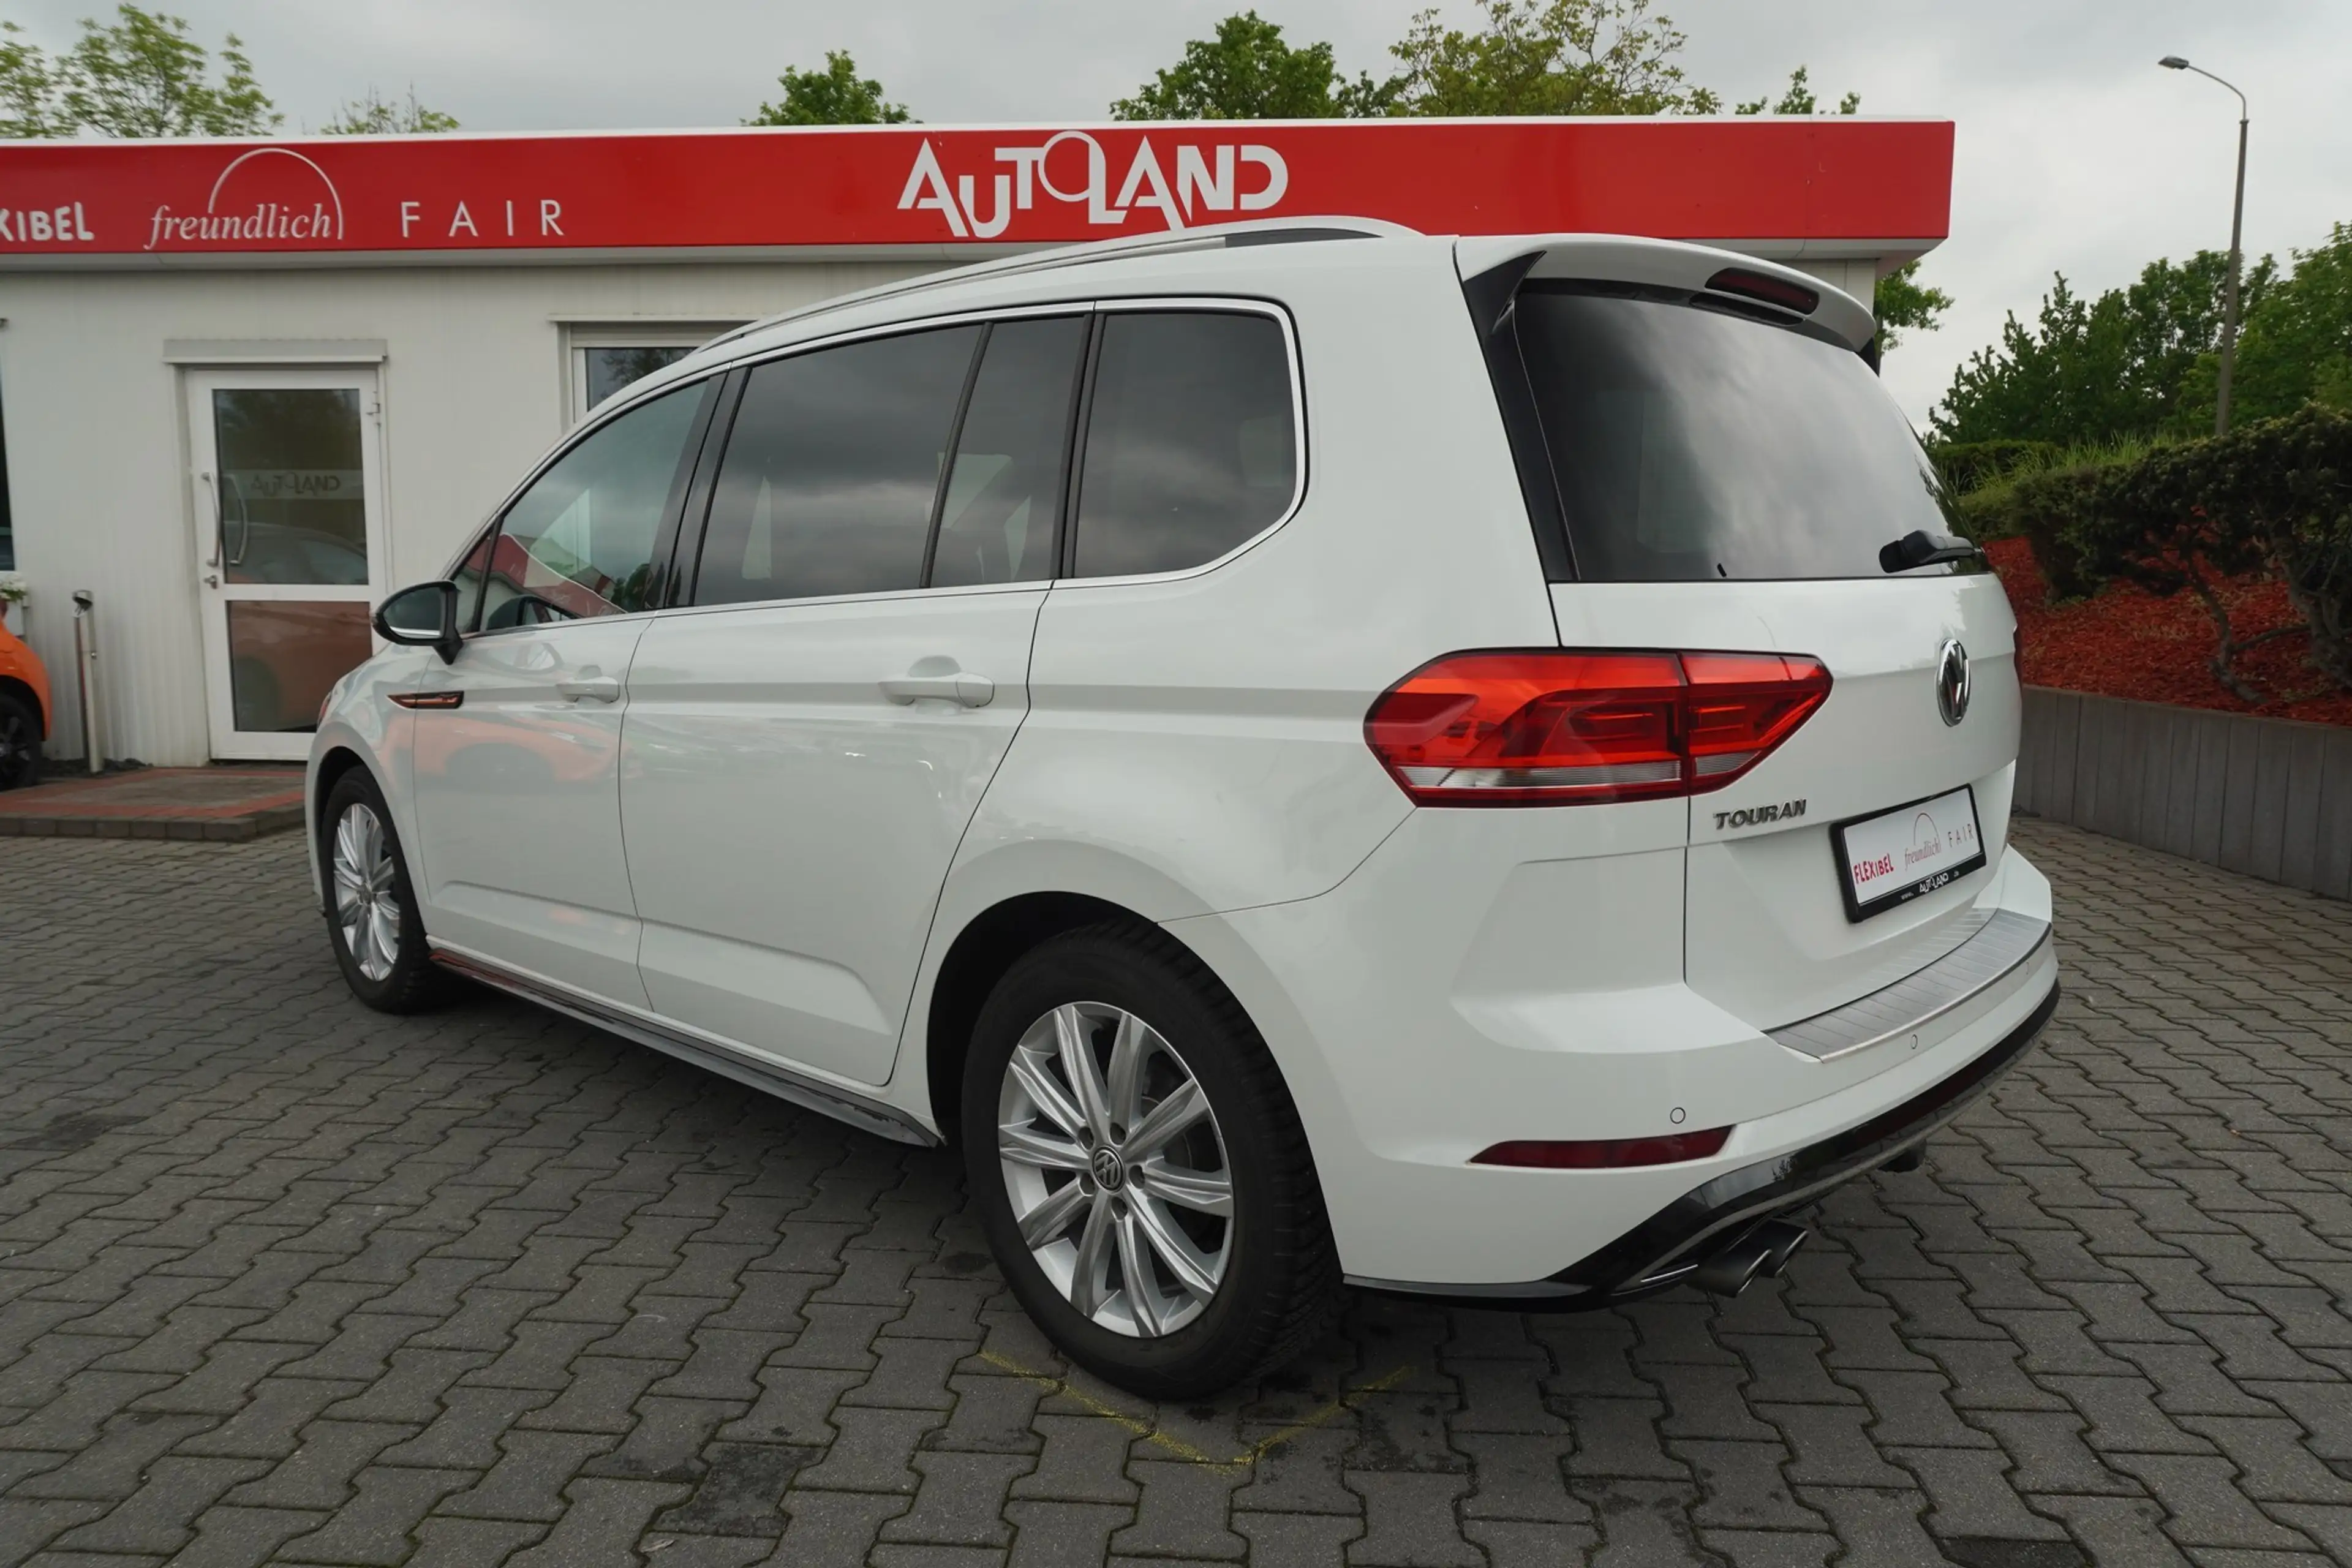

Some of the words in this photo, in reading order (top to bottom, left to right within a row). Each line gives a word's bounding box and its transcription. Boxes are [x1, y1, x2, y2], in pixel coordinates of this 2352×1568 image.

[143, 203, 331, 249] freundlich
[401, 200, 564, 237] FAIR
[1714, 799, 1806, 830] TOURAN
[1853, 853, 1894, 884] FLEXIBEL
[1904, 838, 1942, 871] freundlich
[1948, 823, 1973, 848] FAIR
